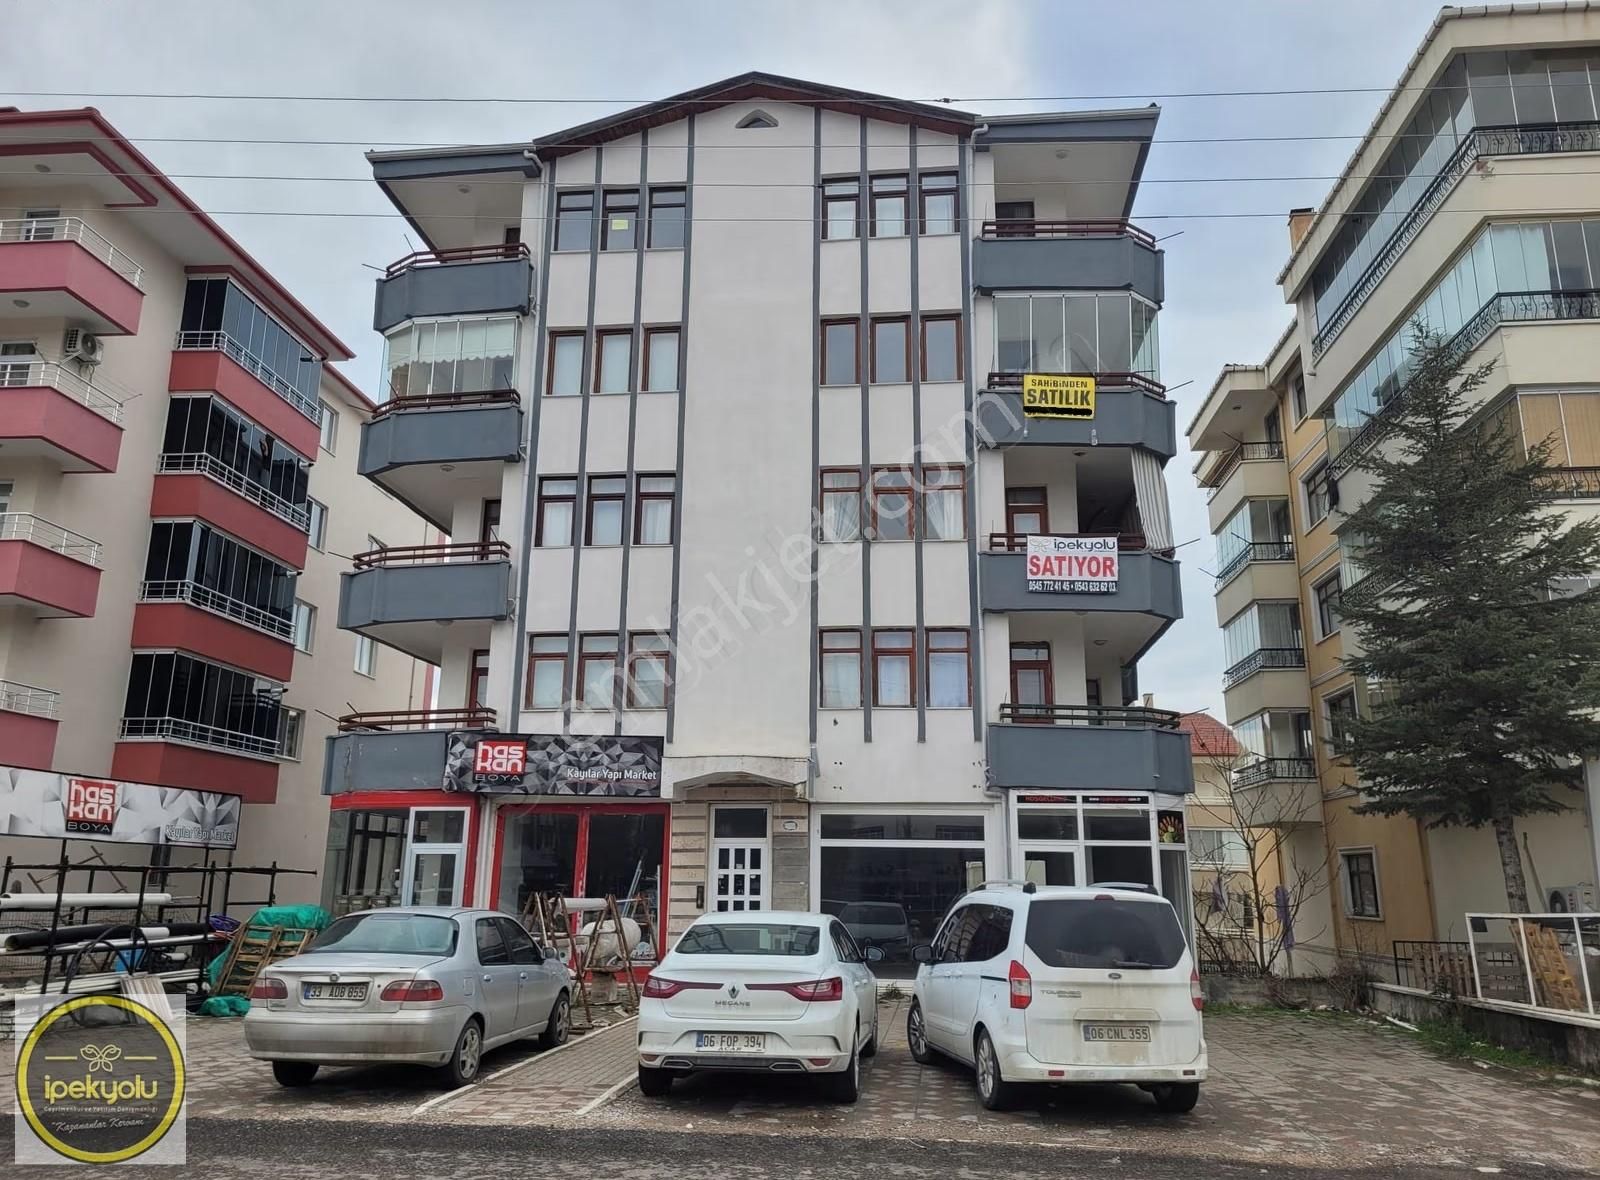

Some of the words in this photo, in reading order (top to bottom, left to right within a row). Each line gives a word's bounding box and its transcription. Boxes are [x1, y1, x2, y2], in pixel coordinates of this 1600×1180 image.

[1027, 388, 1091, 406] SATILIK
[1054, 538, 1116, 552] ipekyolu
[1028, 555, 1116, 577] SATIYOR
[1028, 580, 1043, 590] 0545
[1044, 581, 1054, 590] 772
[1054, 581, 1062, 590] 41
[1062, 582, 1070, 591] 45
[1074, 582, 1088, 592] 0543
[567, 768, 600, 780] Kayılar
[602, 769, 622, 780] Yapı
[624, 769, 657, 780] Market
[67, 821, 110, 832] BOYA
[210, 829, 234, 841] Market
[311, 986, 322, 998] 33
[1090, 1028, 1104, 1040] 06
[1106, 1028, 1126, 1040] CNL
[1129, 1028, 1148, 1040] 355
[703, 1035, 715, 1047] 06
[720, 1035, 738, 1047] FOP
[744, 1036, 762, 1048] 394
